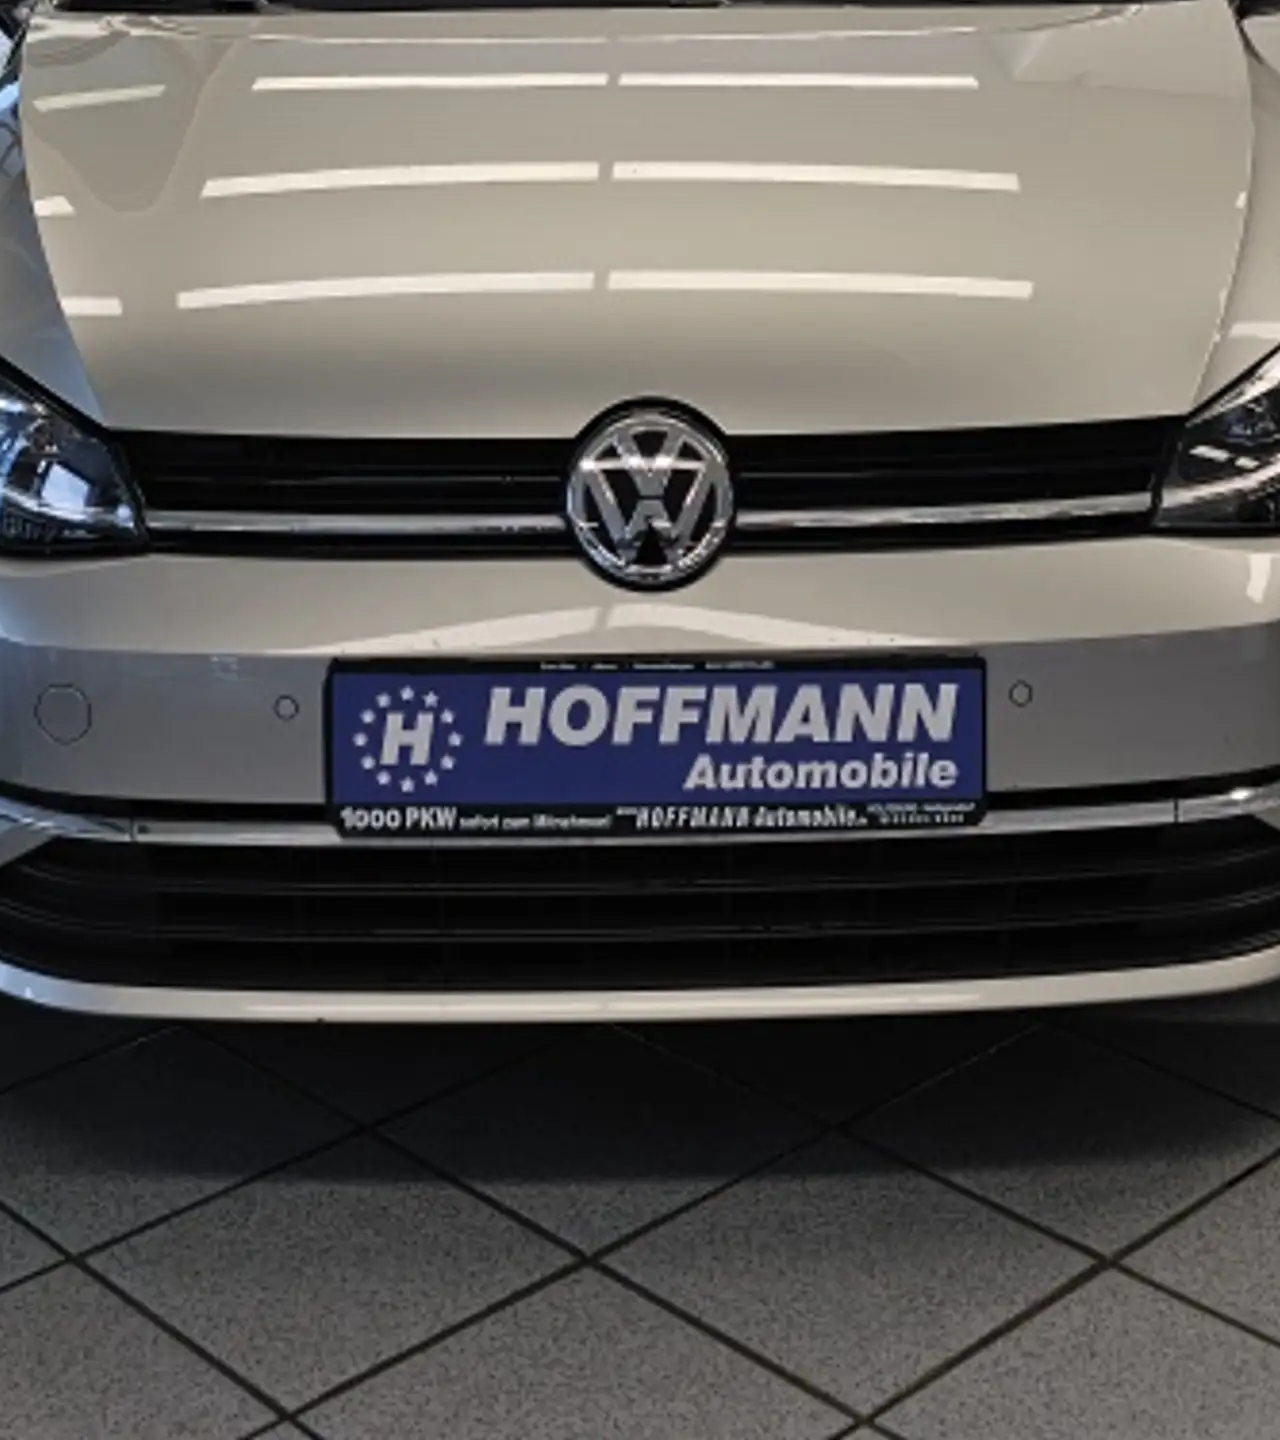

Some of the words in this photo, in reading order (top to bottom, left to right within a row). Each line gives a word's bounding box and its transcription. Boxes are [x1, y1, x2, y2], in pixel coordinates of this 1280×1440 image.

[379, 711, 435, 766] H
[483, 683, 960, 747] HOFFMANN
[682, 750, 959, 791] Automobile
[340, 807, 402, 830] 1000
[405, 806, 457, 830] PKW
